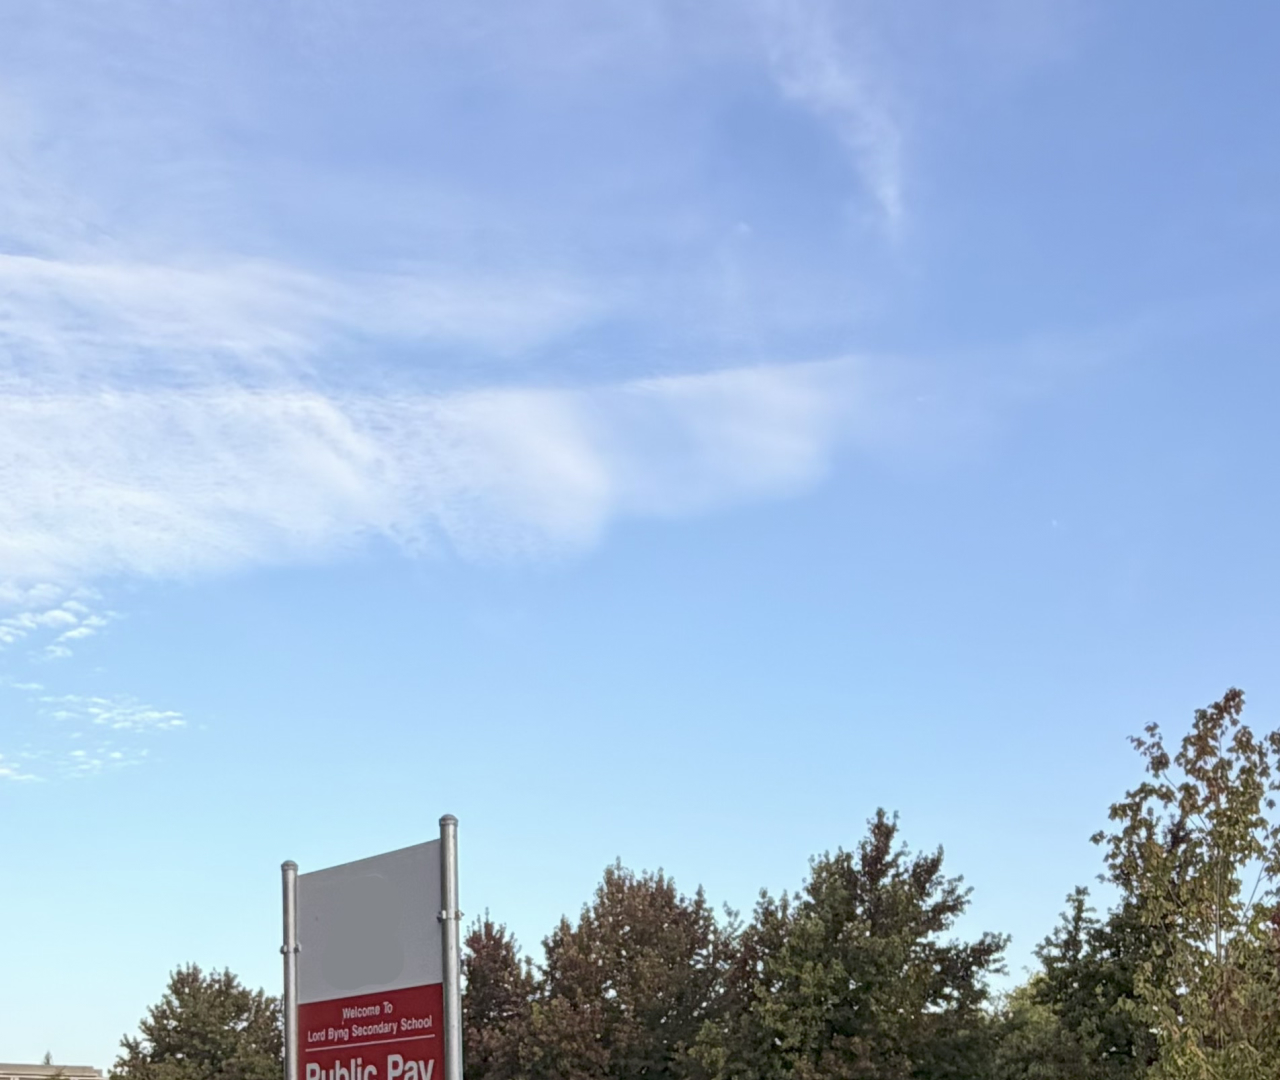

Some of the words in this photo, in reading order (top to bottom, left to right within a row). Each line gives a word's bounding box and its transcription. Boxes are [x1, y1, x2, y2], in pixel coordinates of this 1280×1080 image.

[342, 1005, 380, 1020] Welcome
[383, 1001, 393, 1014] To
[307, 1030, 326, 1042] Lord
[328, 1026, 349, 1041] Byng
[351, 1021, 398, 1037] Secondary
[400, 1015, 433, 1031] School
